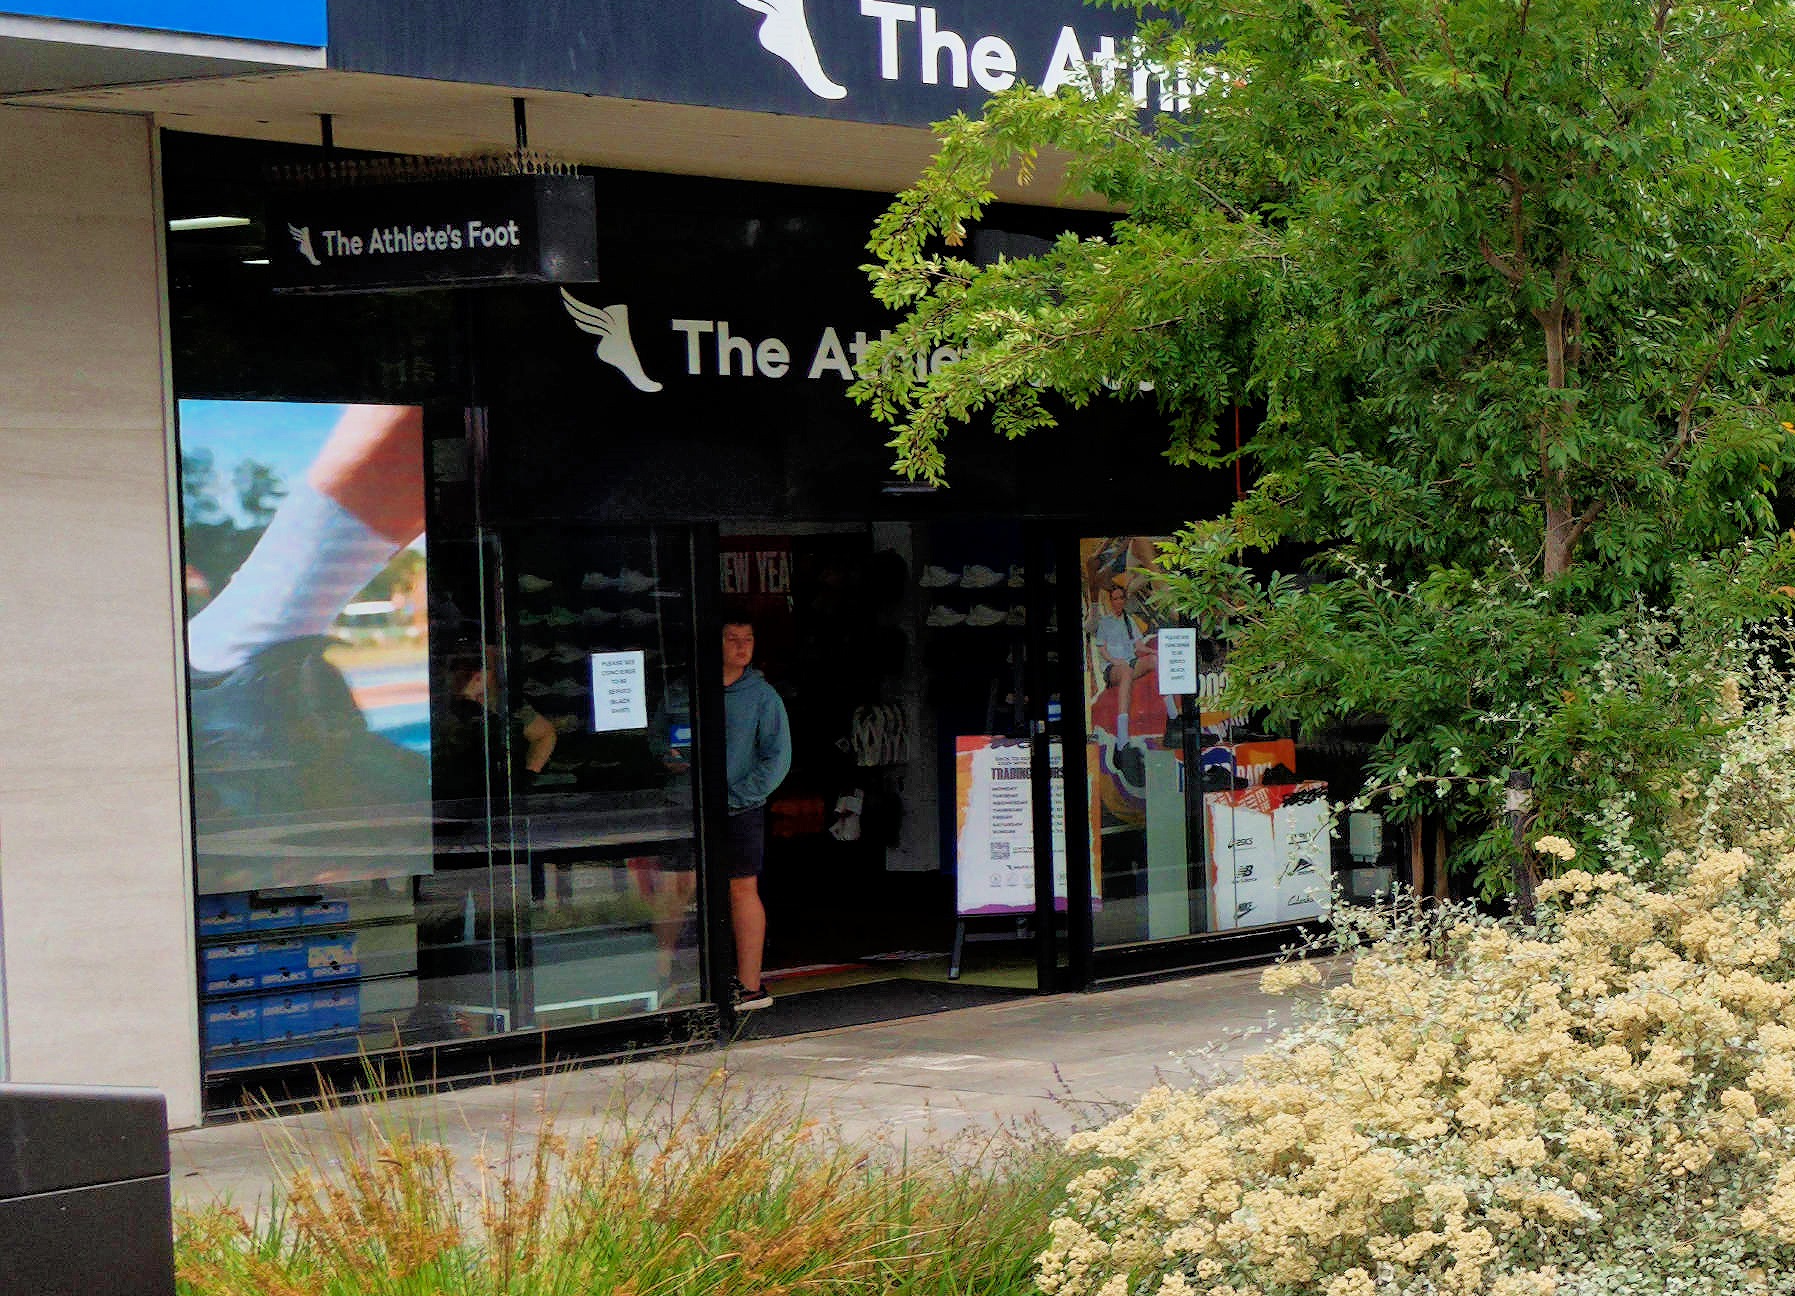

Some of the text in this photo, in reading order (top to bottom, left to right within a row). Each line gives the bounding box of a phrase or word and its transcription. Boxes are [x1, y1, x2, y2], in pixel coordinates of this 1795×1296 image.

[322, 219, 521, 256] The Athlete's Foot
[671, 318, 791, 378] The
